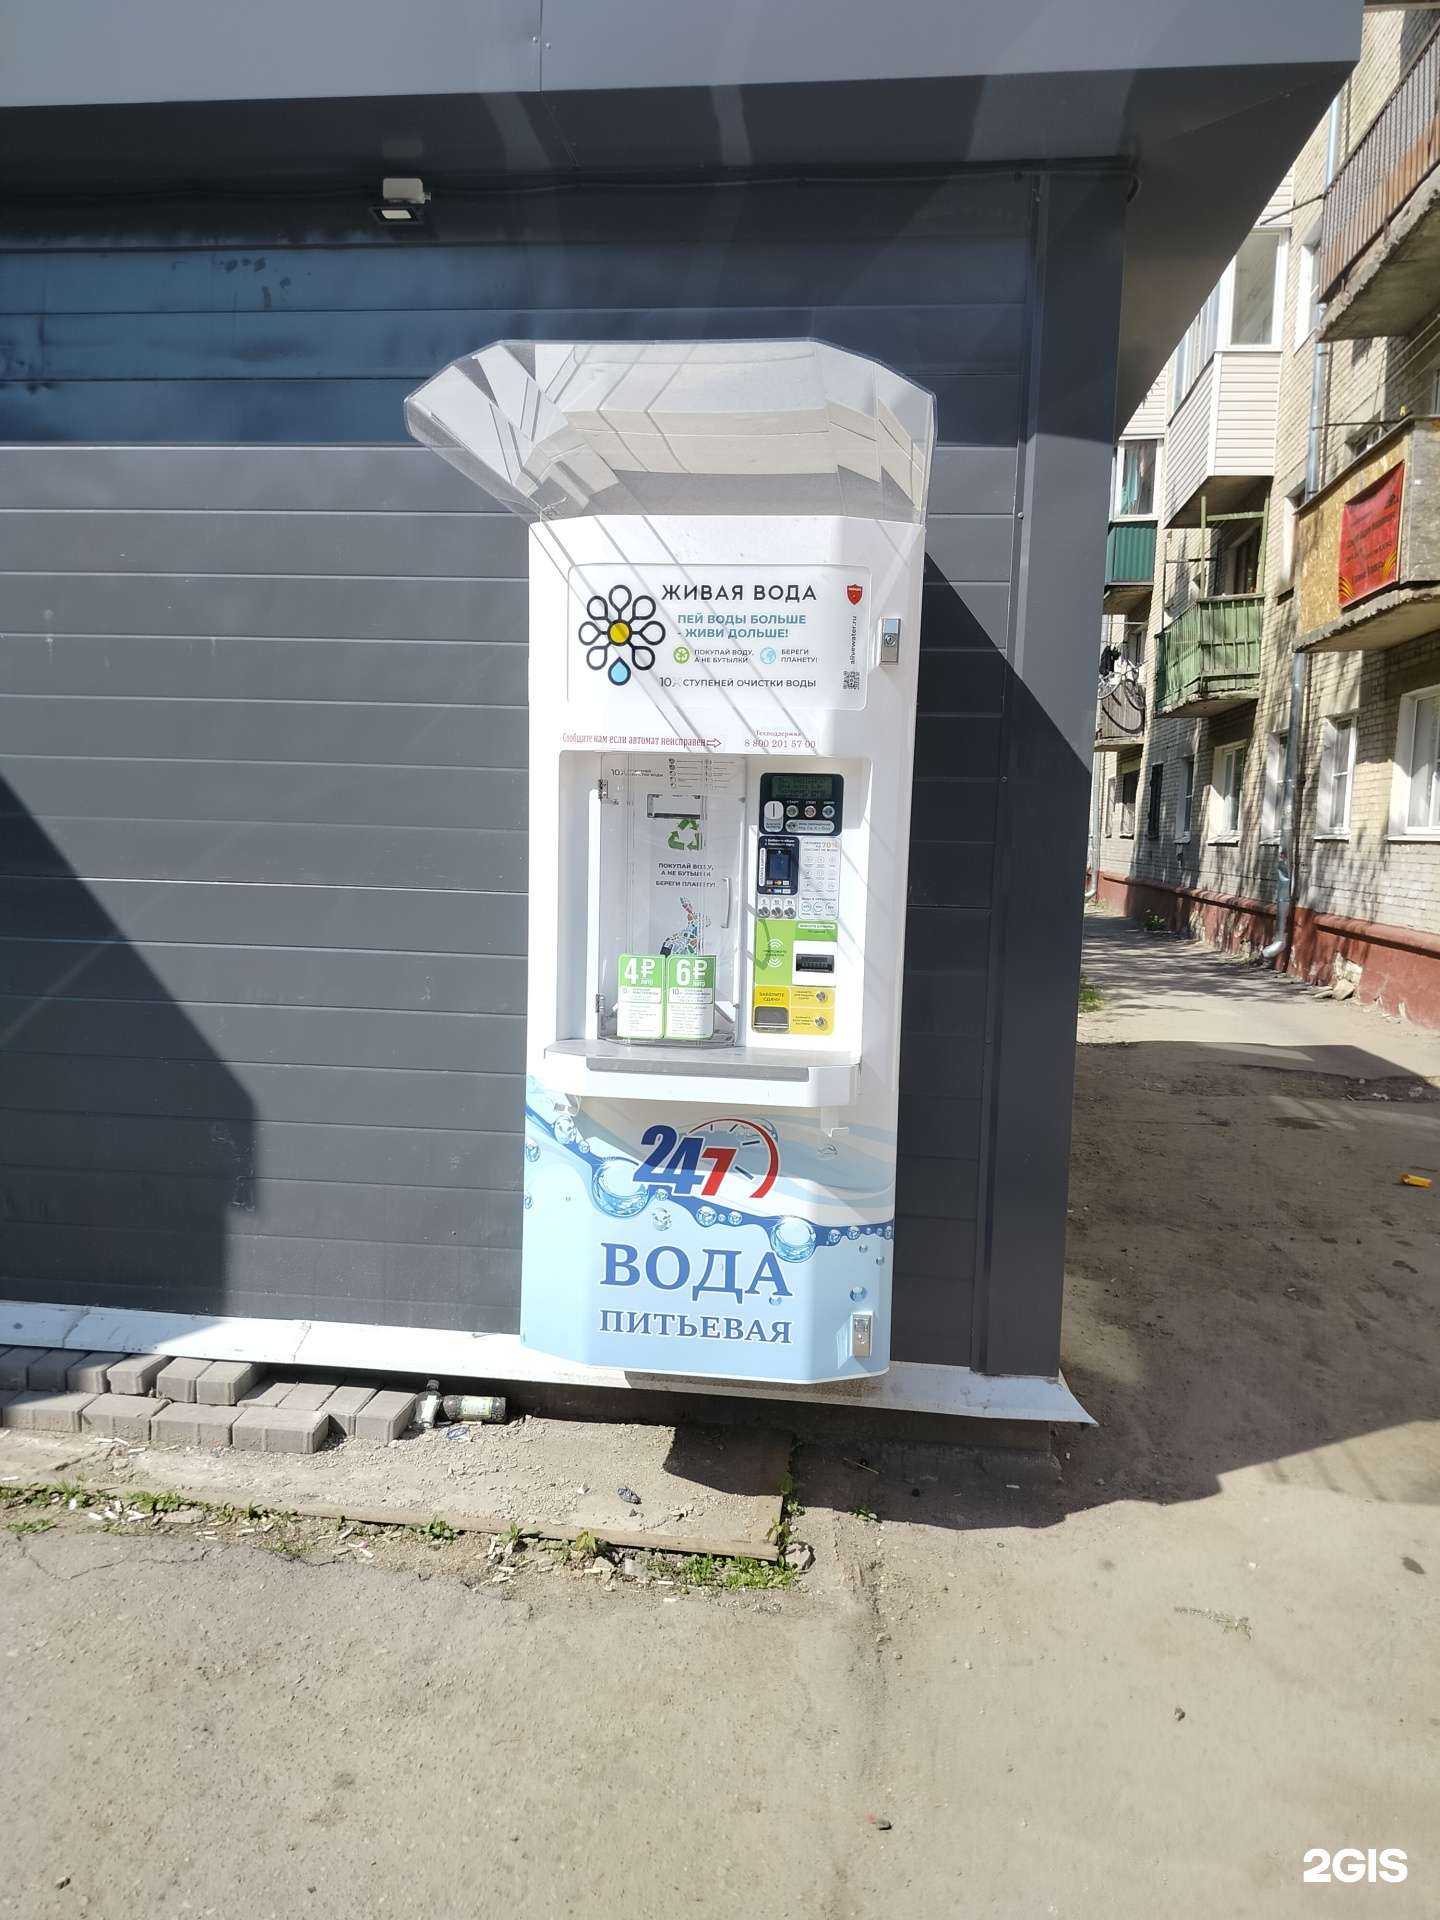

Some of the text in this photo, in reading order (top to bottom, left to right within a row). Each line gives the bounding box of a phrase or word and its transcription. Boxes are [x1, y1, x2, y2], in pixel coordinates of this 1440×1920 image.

[662, 584, 817, 603] ЖИВАЯ ВОДА
[677, 612, 807, 626] ПЕЙ ВОДЫ БОЛЬШЕ
[685, 628, 724, 638] ЖИВИ
[727, 628, 789, 639] ДОЛЬШЕ!
[694, 648, 729, 656] ПОКУПАЙ
[682, 678, 734, 688] СТУПЕНЕЙ
[736, 679, 783, 688] ОЧИСТКИ
[786, 679, 817, 688] ВОДЫ
[609, 736, 627, 744] если
[628, 736, 659, 745] автомат
[660, 737, 706, 749] неисправен
[658, 862, 692, 870] ПОКУПАЙ
[599, 1242, 793, 1304] ВОДА
[599, 1309, 792, 1344] ПИТЬЕВАЯ
